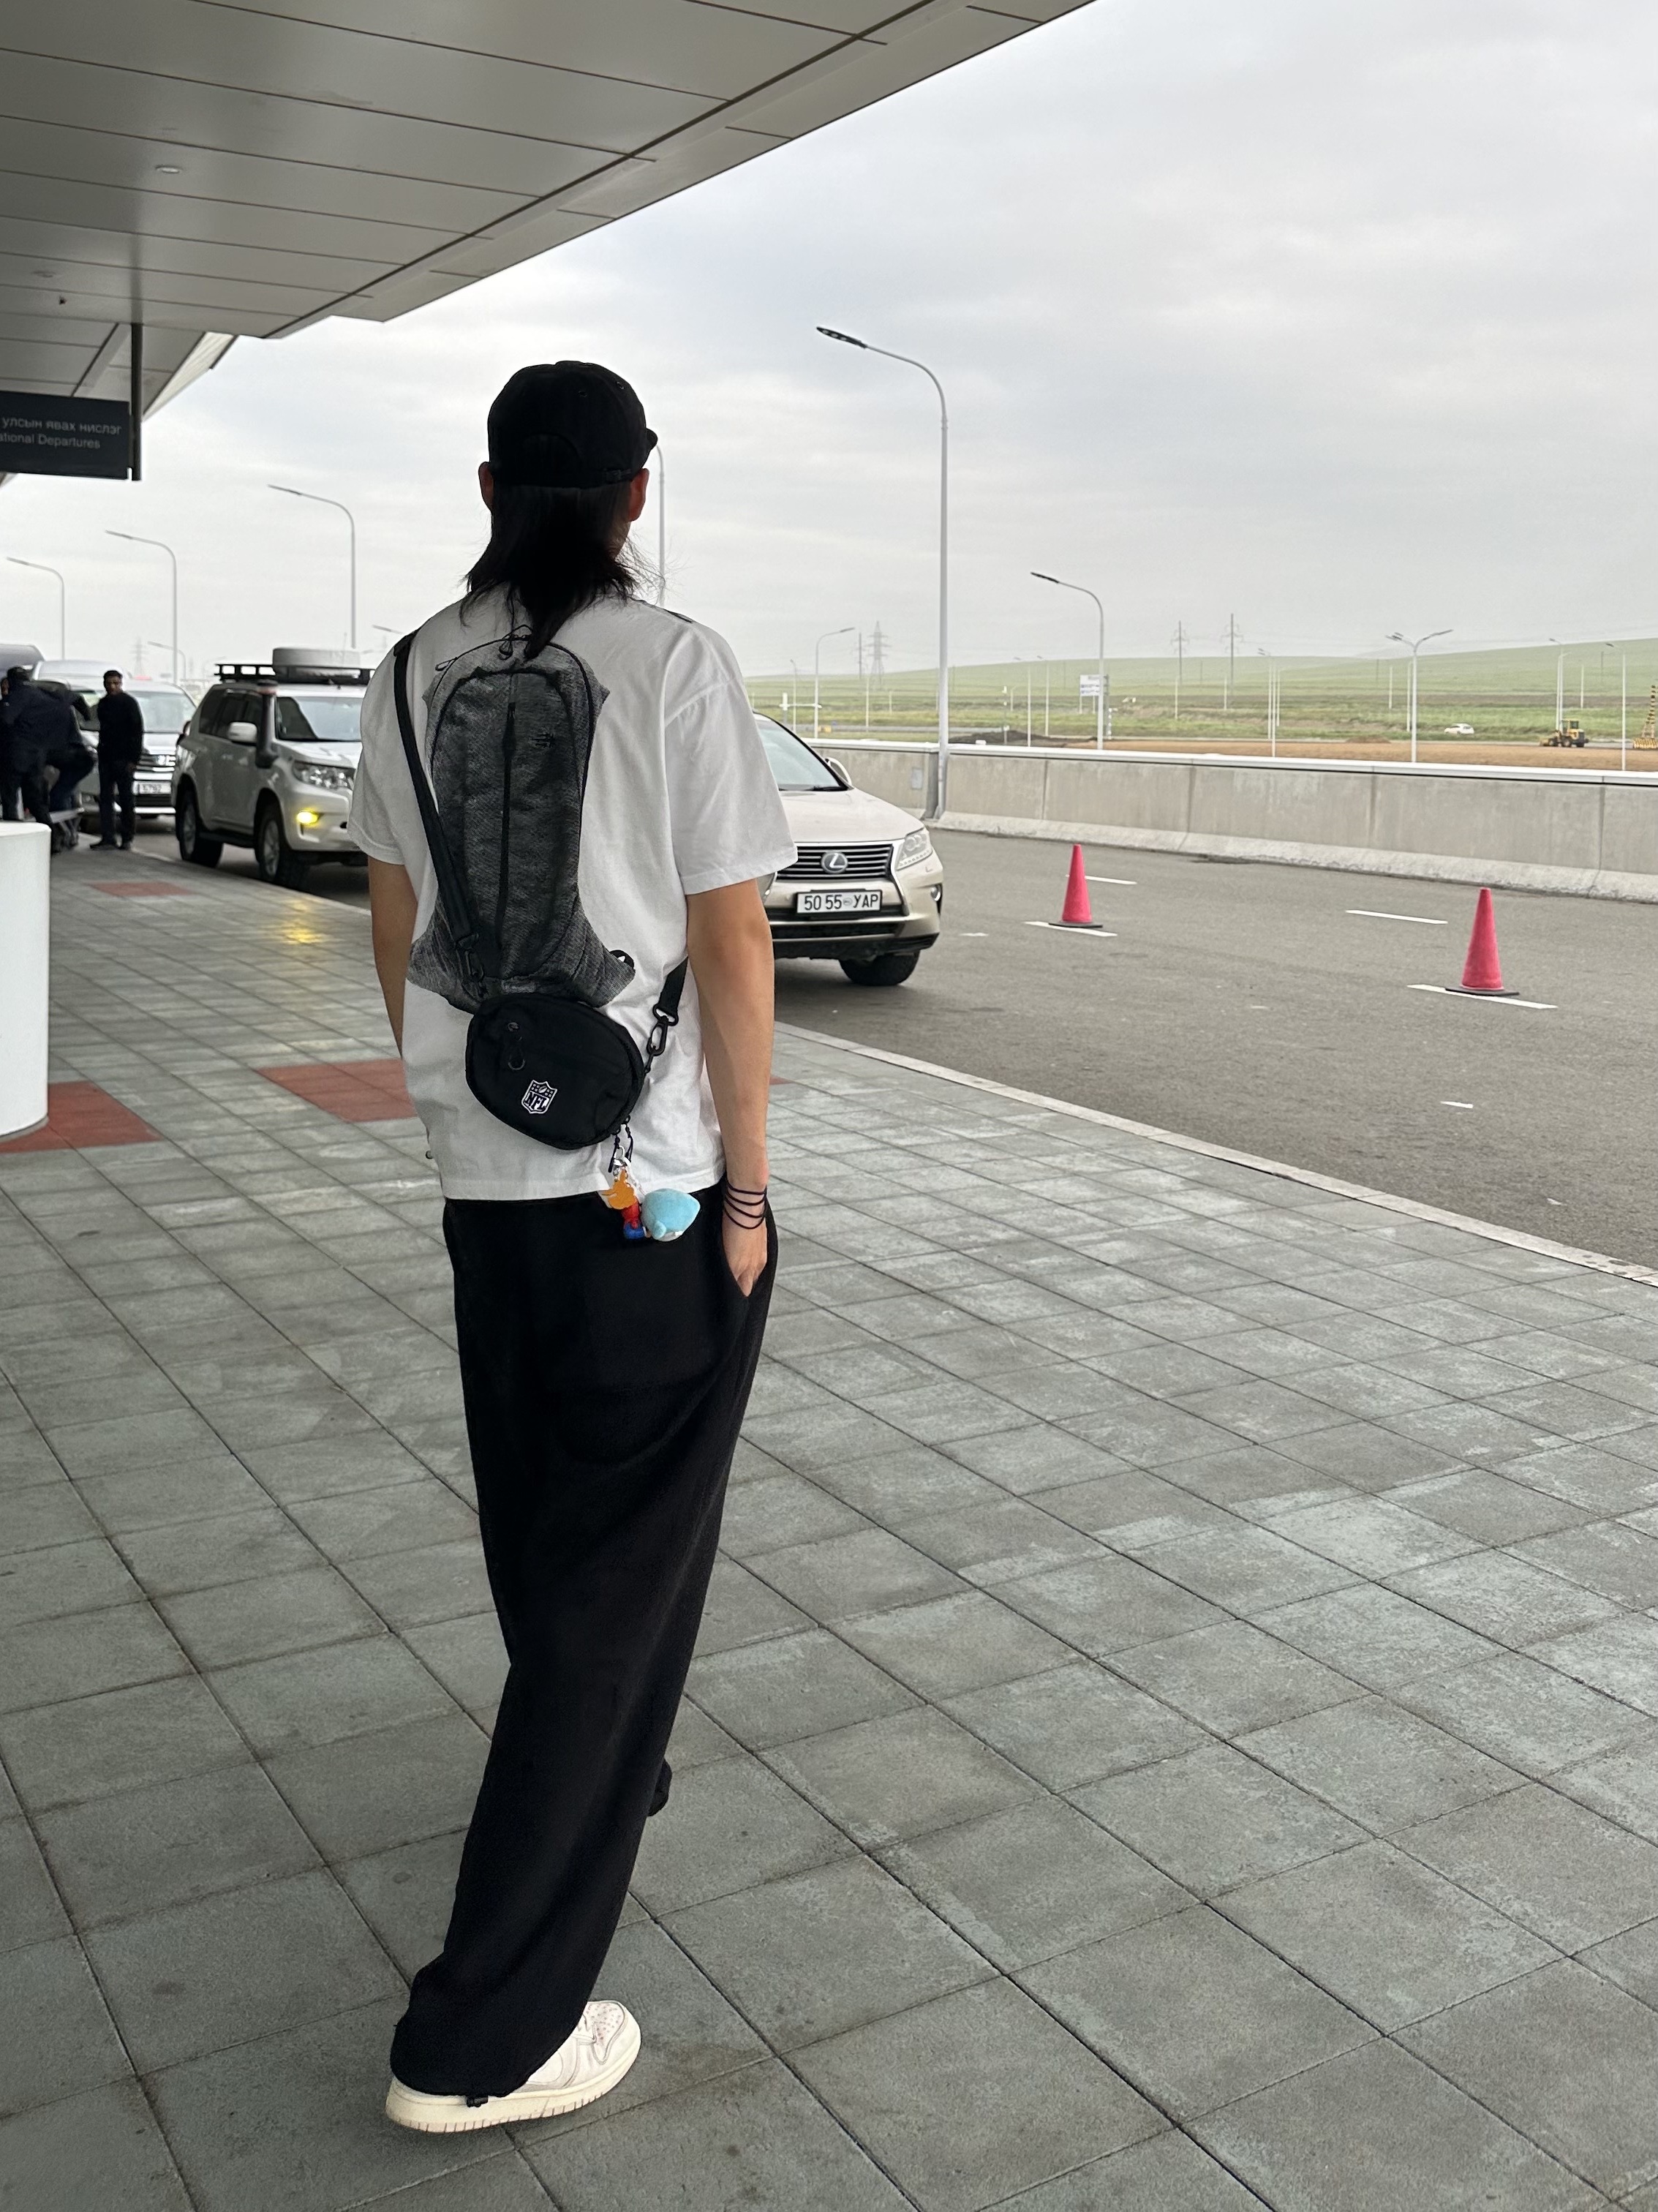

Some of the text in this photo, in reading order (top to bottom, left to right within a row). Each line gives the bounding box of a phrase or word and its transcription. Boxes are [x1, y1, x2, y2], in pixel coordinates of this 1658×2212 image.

[2, 417, 122, 435] улсын явах нислэг
[38, 434, 101, 449] Departures
[524, 1091, 549, 1111] NFL
